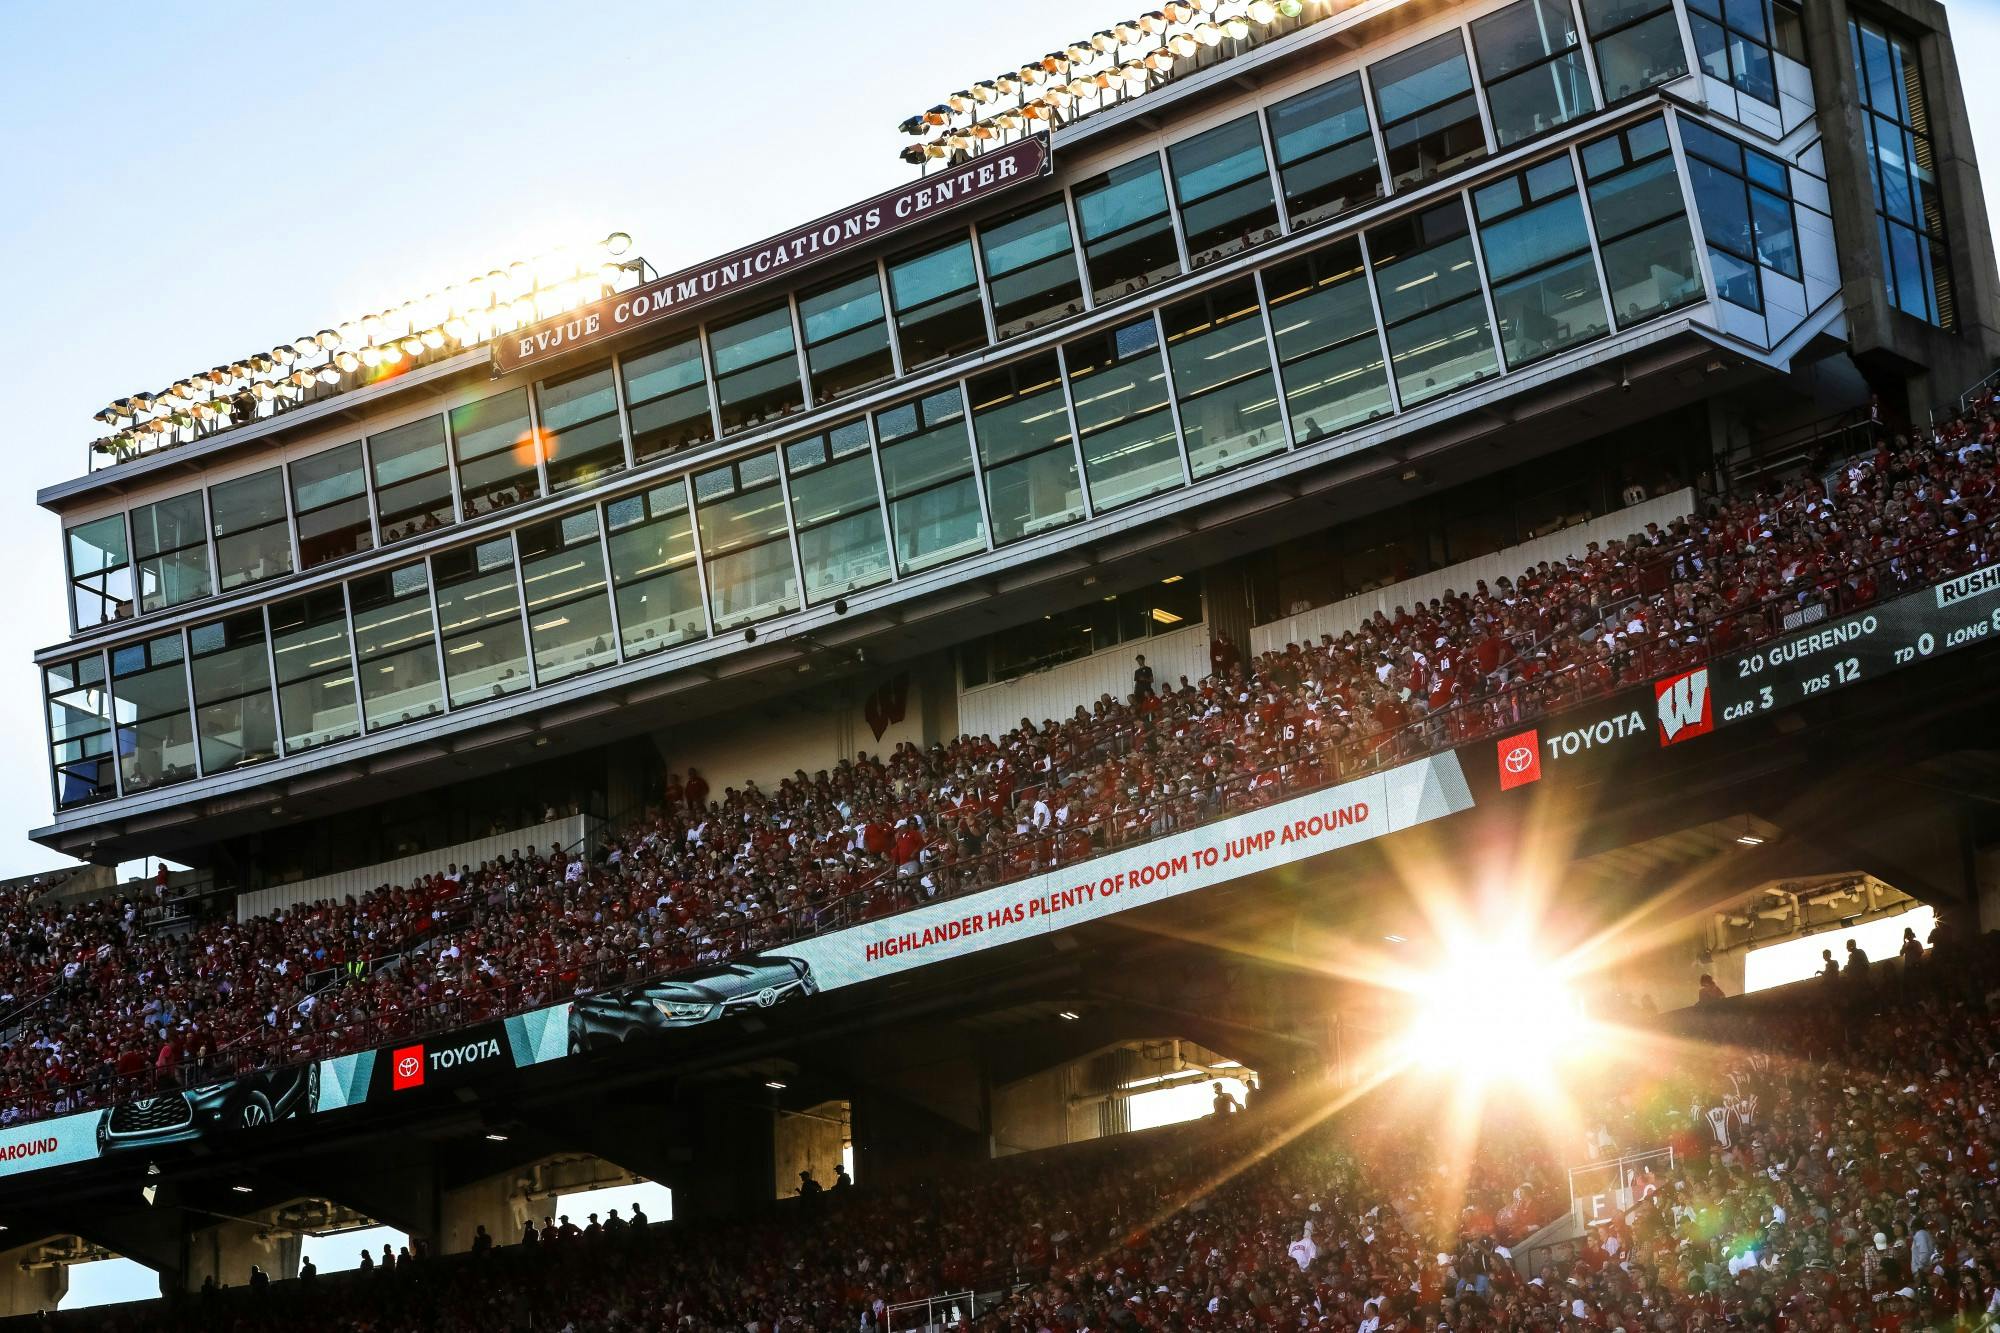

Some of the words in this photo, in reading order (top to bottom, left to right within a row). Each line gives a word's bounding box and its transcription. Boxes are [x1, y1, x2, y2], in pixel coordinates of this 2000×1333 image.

[518, 313, 600, 358] EVJUE
[614, 207, 881, 323] COMMUNICATIONS
[895, 156, 1018, 218] CENTER
[1723, 700, 1754, 721] CAR
[1759, 685, 1774, 709] 3
[1801, 673, 1830, 695] YDS
[1834, 657, 1861, 684] 12
[1894, 646, 1914, 664] TD
[1918, 632, 1935, 655] 0
[1946, 620, 1988, 647] LONG
[1738, 654, 1764, 678] 20
[1769, 615, 1877, 666] GUERENDO
[1546, 711, 1646, 759] TOYOTA
[1658, 669, 1708, 740] W
[866, 915, 984, 962] HIGHLANDER
[988, 903, 1025, 930] HAS
[1029, 882, 1097, 918] PLENTY
[1099, 874, 1124, 897] OF
[1129, 855, 1188, 889] ROOM
[1192, 847, 1219, 870] TO
[1223, 830, 1275, 862] JUMP
[1280, 802, 1369, 845] AROUND
[430, 1038, 500, 1070] TOYOTA
[0, 1137, 58, 1161] AROUND
